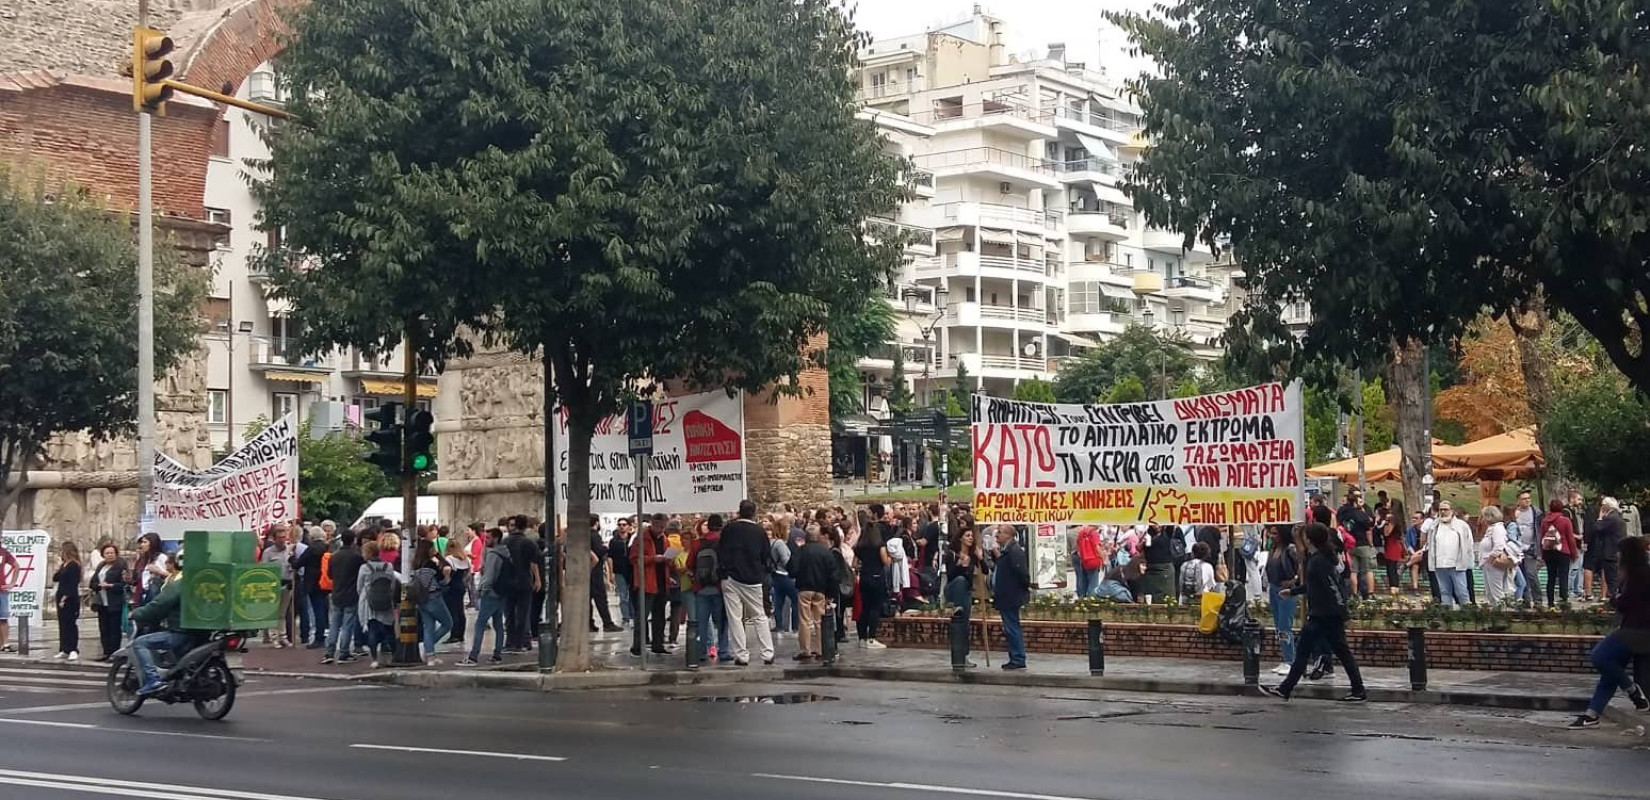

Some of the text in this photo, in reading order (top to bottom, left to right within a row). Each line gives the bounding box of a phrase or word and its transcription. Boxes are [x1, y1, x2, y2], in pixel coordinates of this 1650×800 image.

[634, 401, 647, 435] P
[972, 395, 981, 423] Η
[1174, 384, 1285, 421] ΔΙΚΑΙΩΜΑΤΑ
[972, 424, 1056, 488] ΚΑΤΩ
[1058, 426, 1080, 446] ΤΟ
[1186, 415, 1276, 444] ΕΚΤΡΩΜΑ
[1055, 452, 1083, 484] ΤΑ
[1088, 451, 1142, 483] ΧΕΡΙΑ
[1183, 465, 1220, 488] ΤΗΝ
[1226, 462, 1299, 489] ΑΠΕΡΓΙΑ
[975, 490, 1068, 510] ΑΓΩΝΙΣΤΙΚΕΣ
[1072, 488, 1135, 510] ΚΙΝΗΣΕΙΣ
[1164, 502, 1225, 524] ΤΑΞΙΚΗ
[1232, 498, 1291, 524] ΠΟΡΕΙΑ
